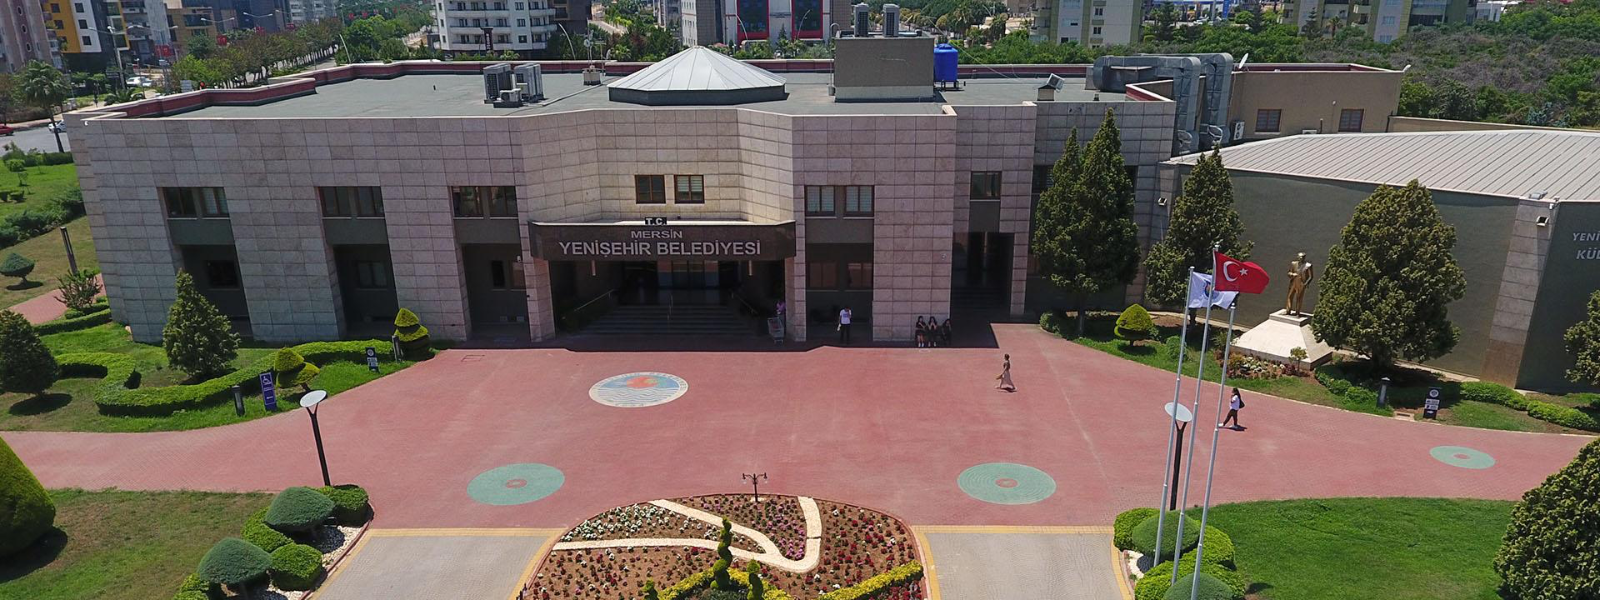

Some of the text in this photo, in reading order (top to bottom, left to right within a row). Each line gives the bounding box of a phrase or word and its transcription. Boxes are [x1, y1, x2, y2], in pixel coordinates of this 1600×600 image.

[645, 217, 667, 226] T.C.
[631, 229, 683, 239] MERSİN
[559, 239, 761, 257] YENİŞEHİR BELEDİYESİ
